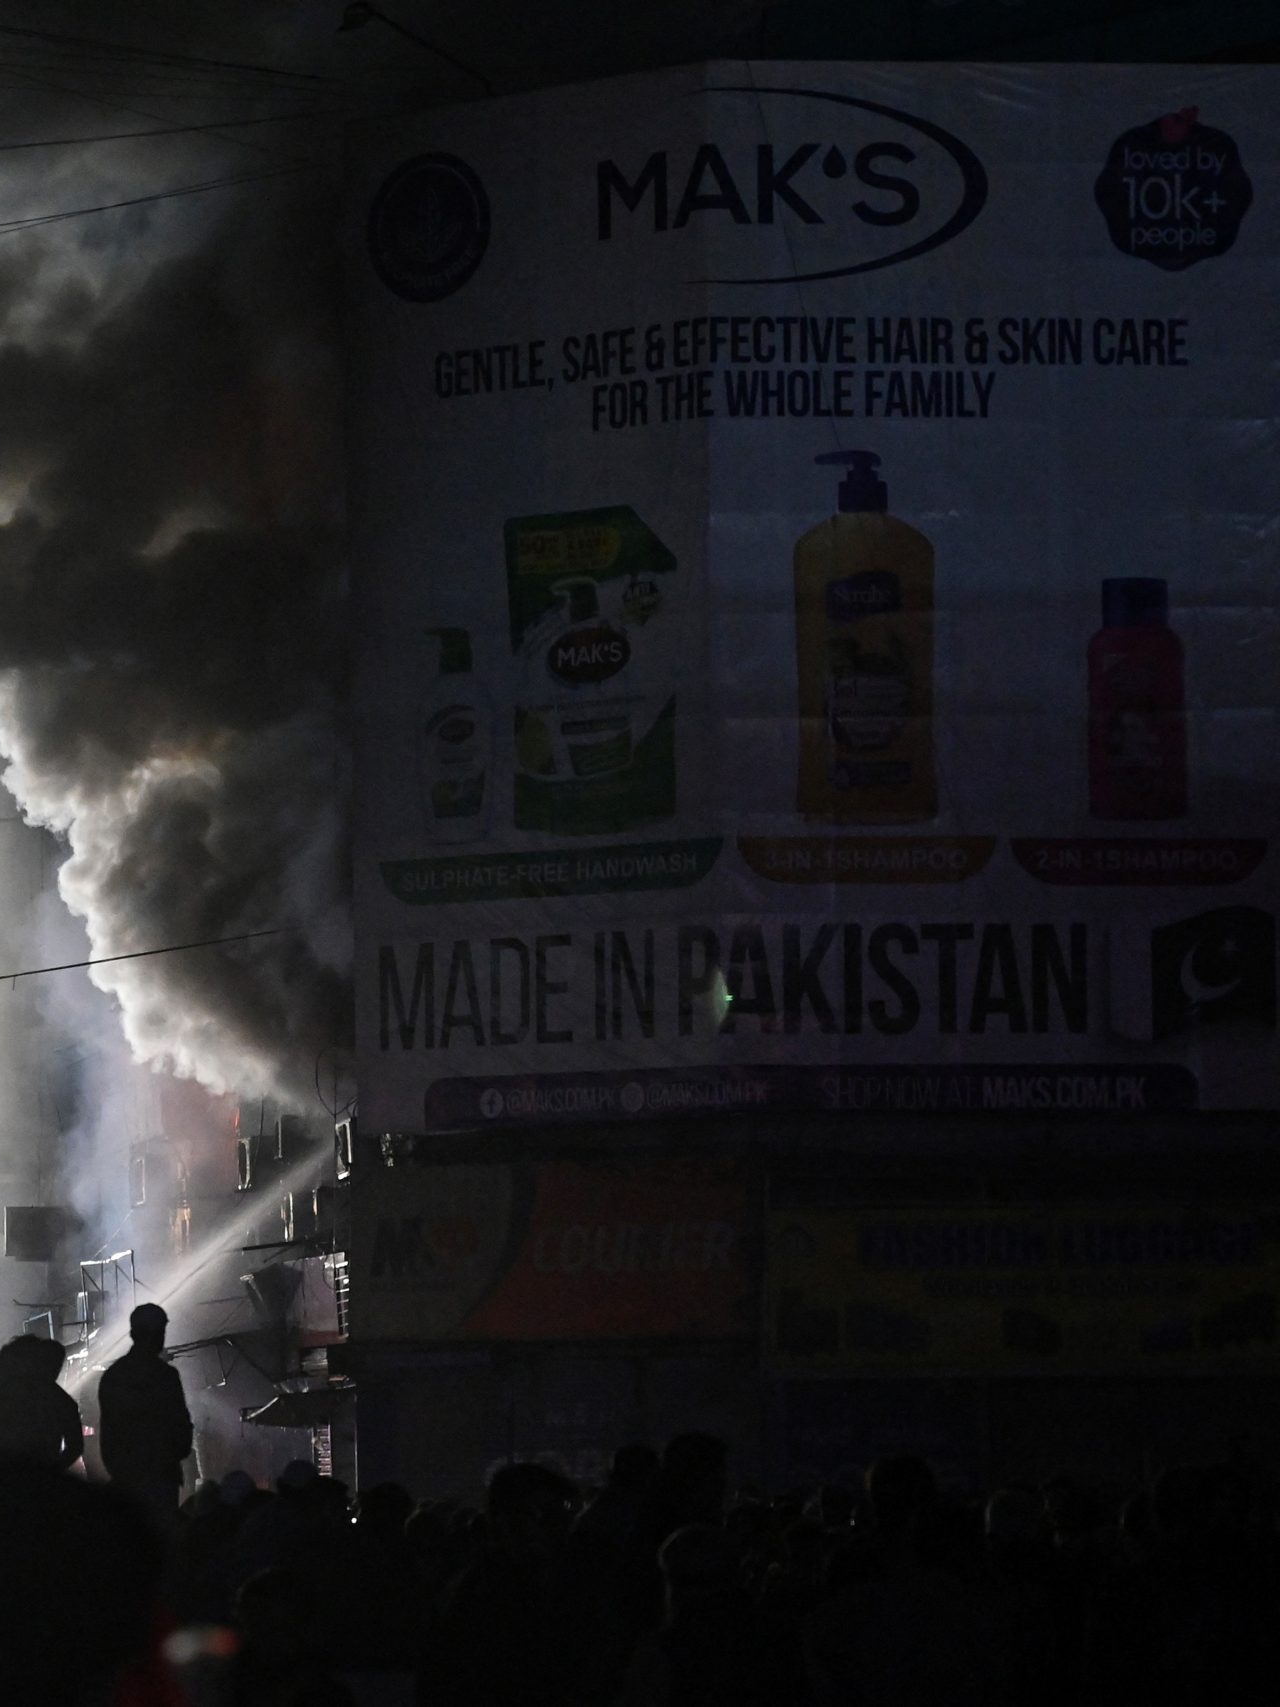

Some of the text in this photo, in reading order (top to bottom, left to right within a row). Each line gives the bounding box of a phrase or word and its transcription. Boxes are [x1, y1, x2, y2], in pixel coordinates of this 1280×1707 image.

[1123, 144, 1228, 176] loved by
[596, 141, 921, 240] MAK'S
[1121, 173, 1228, 221] 10k+
[1130, 222, 1217, 252] people
[433, 315, 1192, 400] GENTLE, SAFE & EFFECTIVE HAIR & SKIN CARE
[590, 369, 997, 432] FOR THE WHOLE FAMILY
[402, 852, 698, 893] SULPHATE-FREE HANDWASH
[378, 922, 1088, 1051] MADE IN PAKISTAN
[982, 1074, 1147, 1109] MAKS.COM.PK
